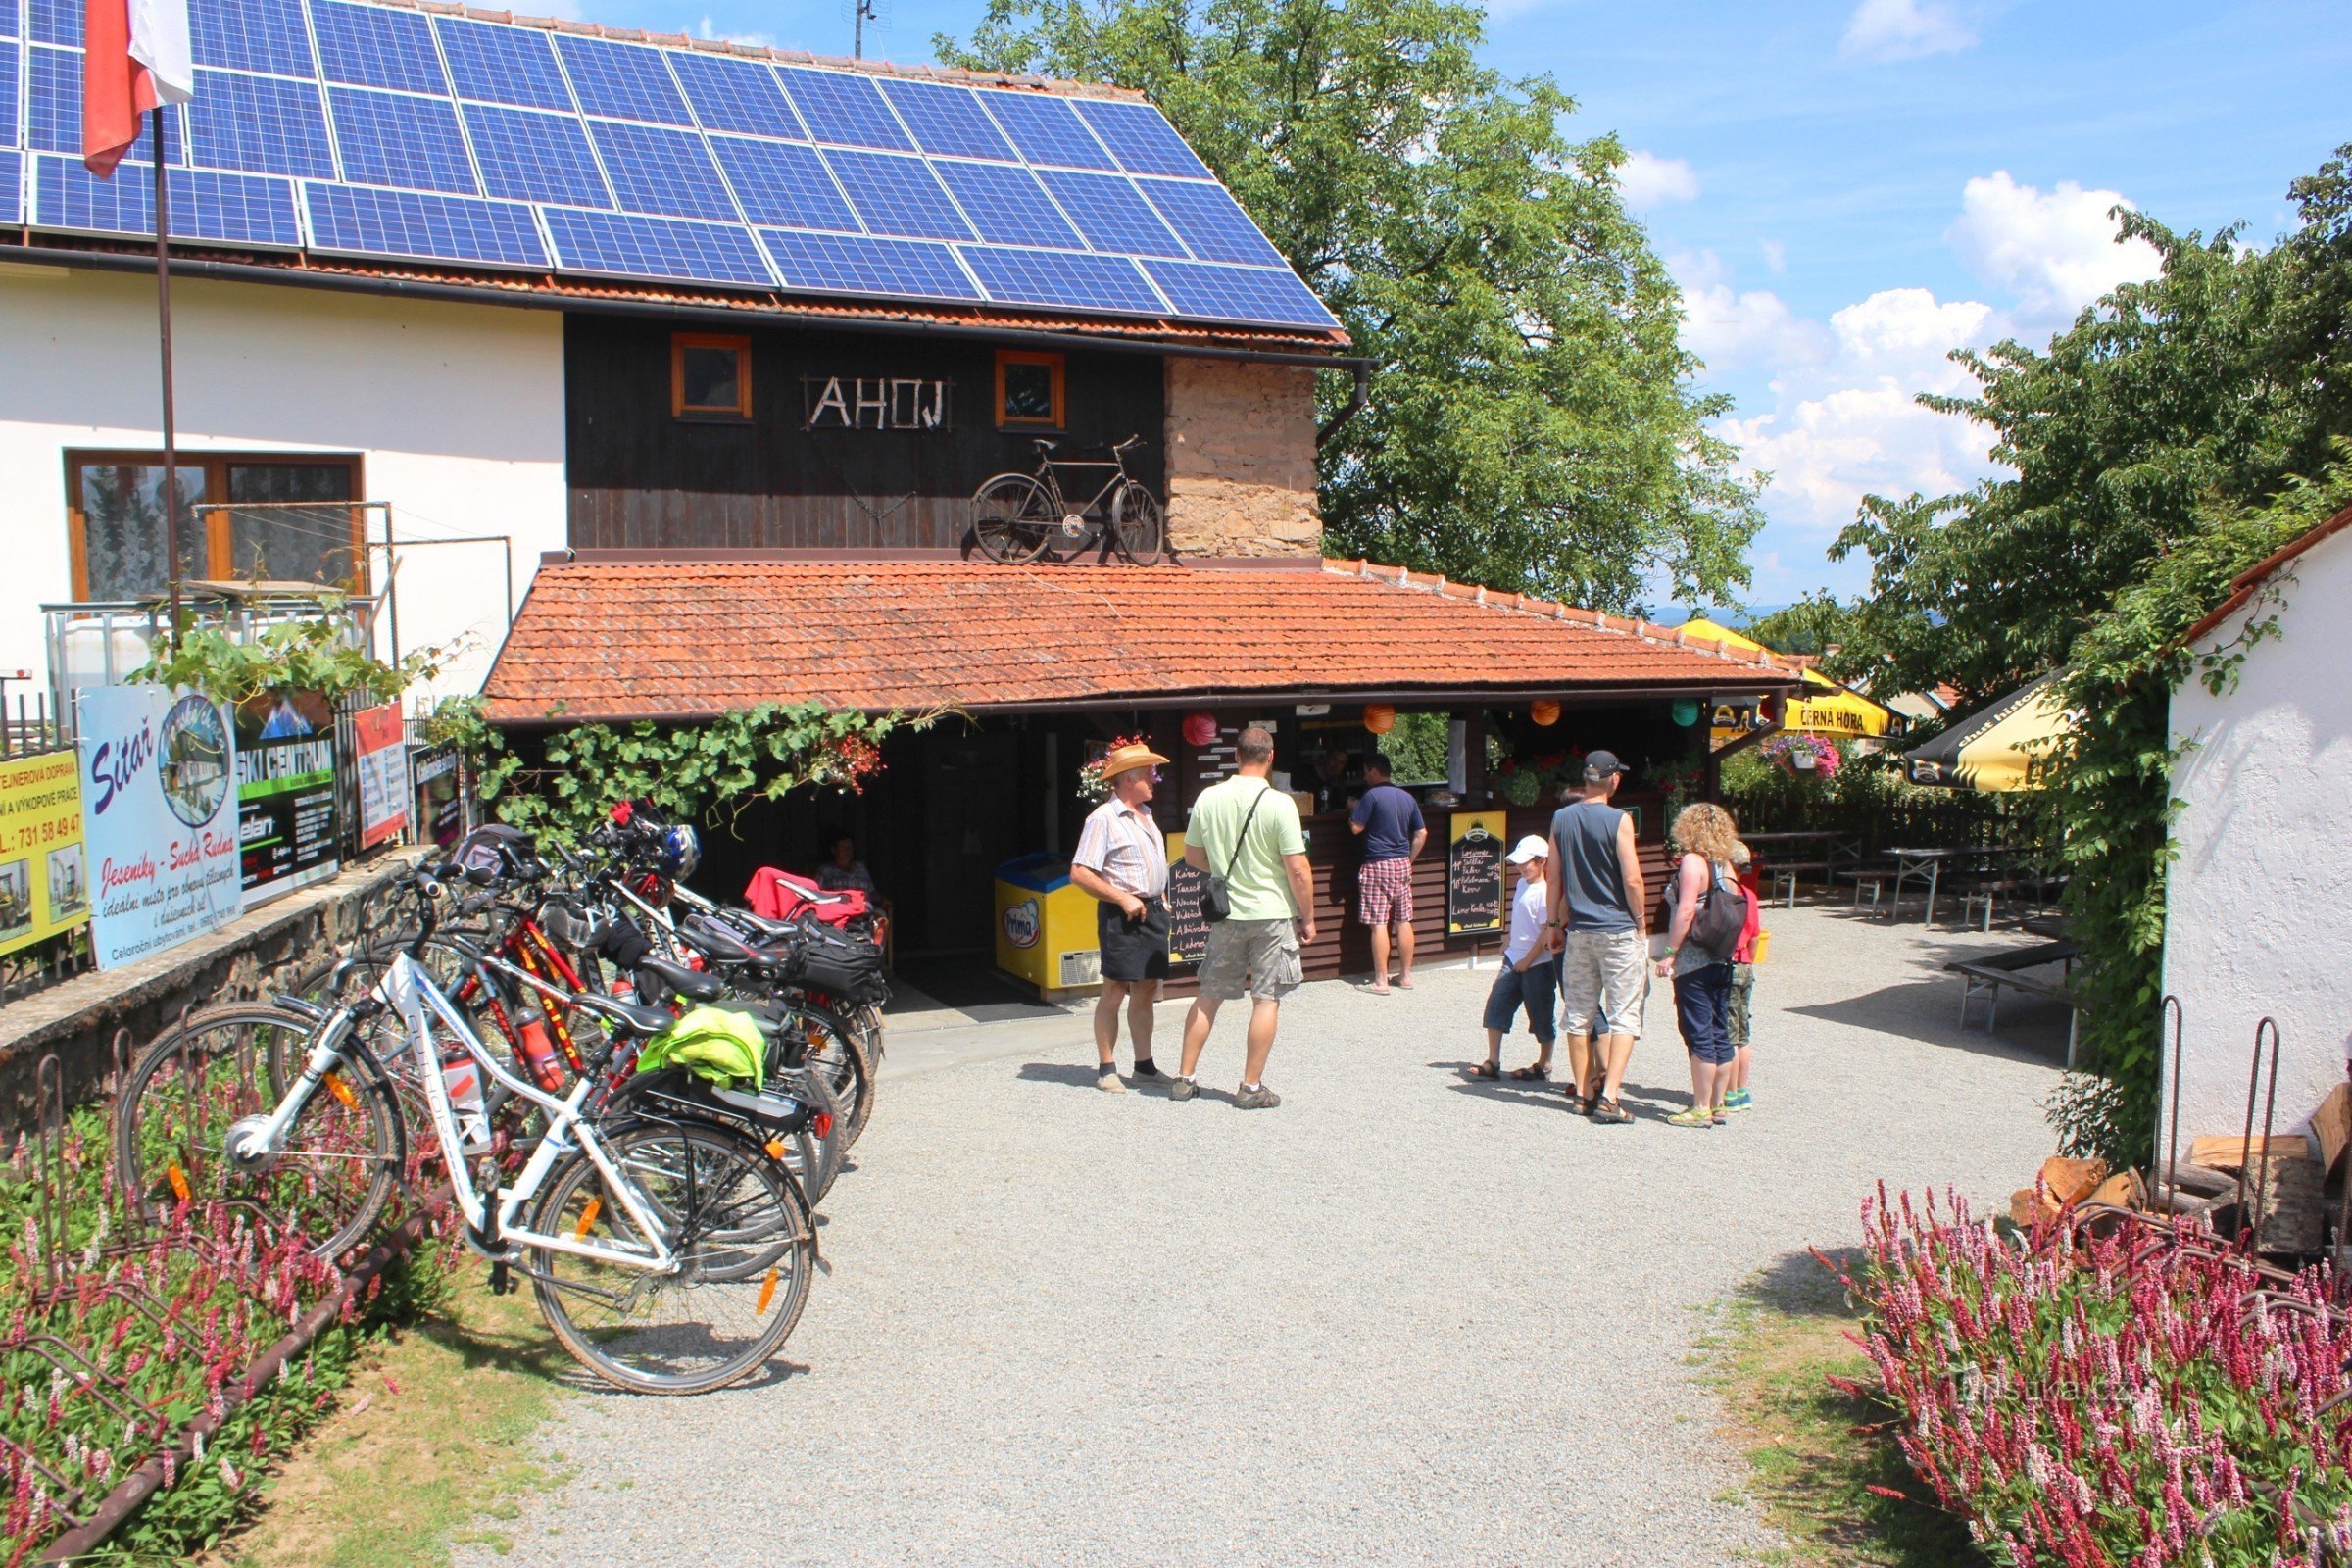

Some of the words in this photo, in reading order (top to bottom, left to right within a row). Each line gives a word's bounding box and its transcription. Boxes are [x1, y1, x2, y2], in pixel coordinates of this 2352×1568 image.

[810, 376, 943, 430] AHOJ
[1837, 710, 1865, 731] HORA
[46, 762, 75, 781] DOPRAVA
[236, 749, 264, 785] SKI
[266, 739, 333, 780] CENTRUM
[8, 801, 15, 815] A
[19, 825, 38, 848] 731
[42, 821, 53, 842] 58
[57, 817, 68, 837] 49
[70, 813, 79, 833] 47
[240, 814, 273, 841] elan
[101, 851, 157, 900] Jeseníky
[202, 831, 234, 858] Rudná
[1006, 913, 1032, 937] Prima
[407, 1014, 448, 1134] AUTHOR
